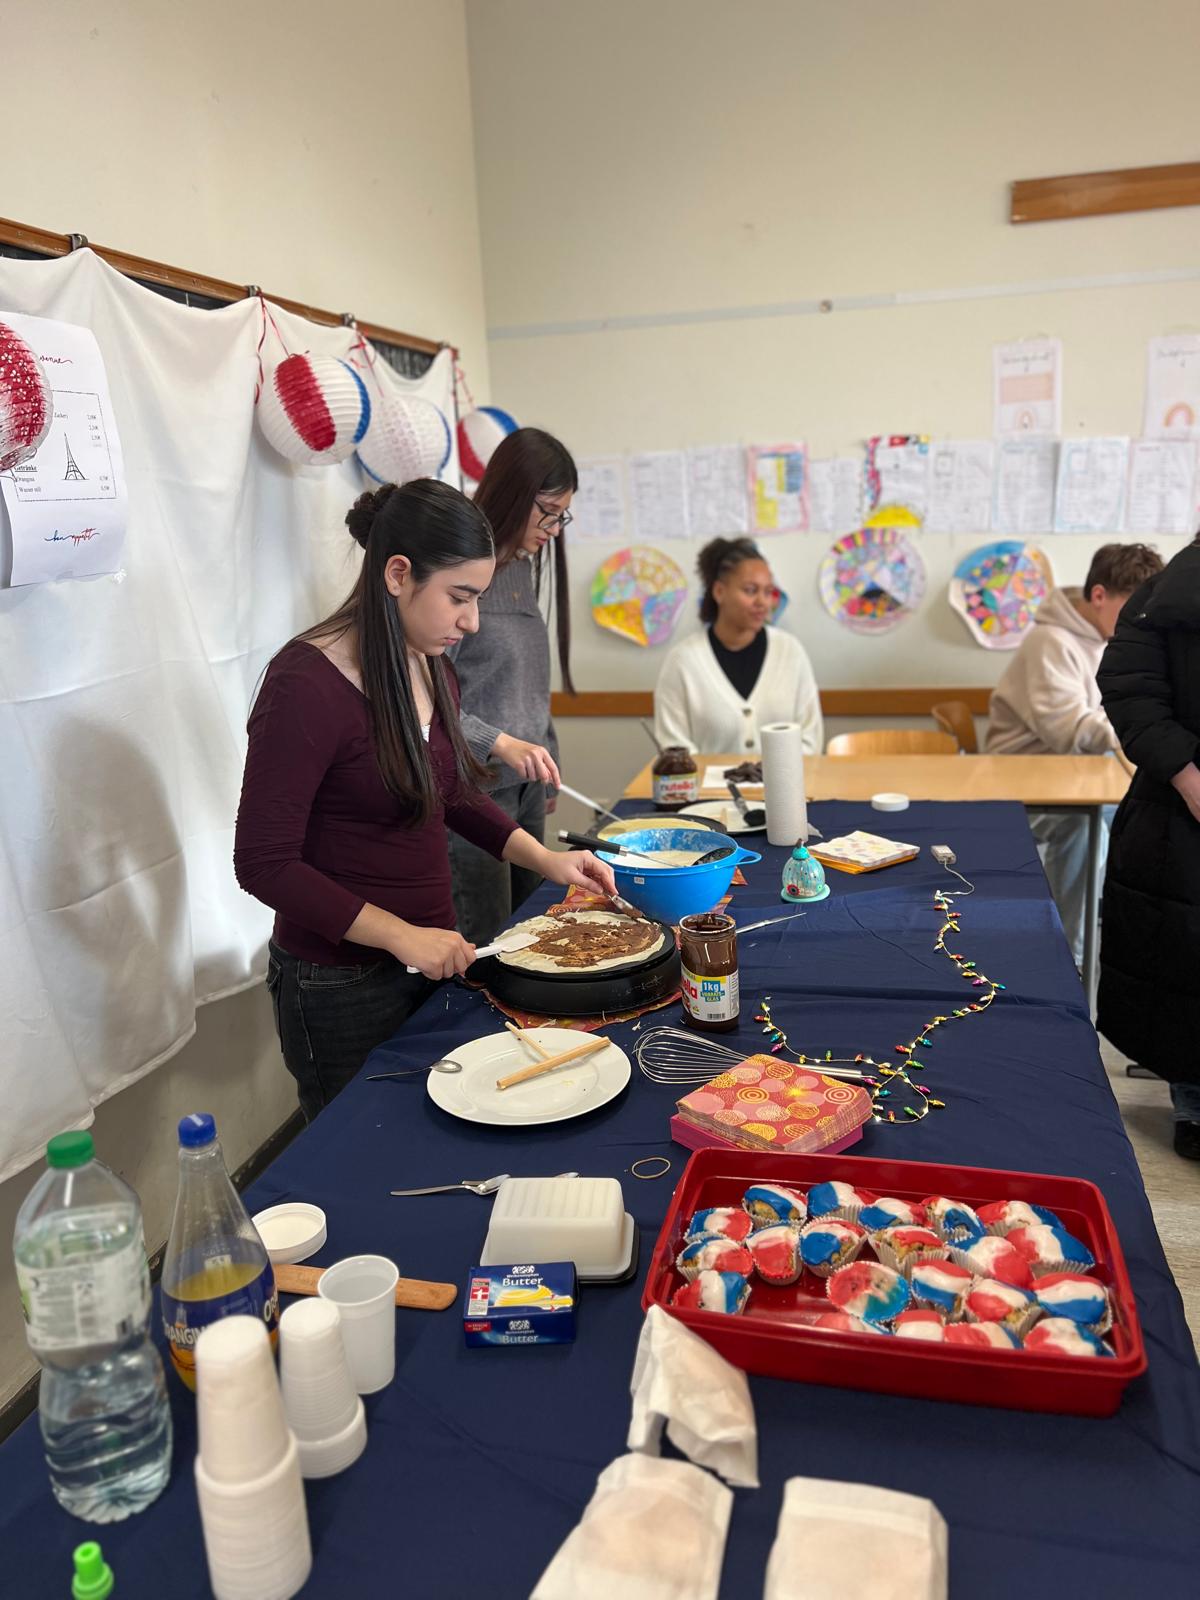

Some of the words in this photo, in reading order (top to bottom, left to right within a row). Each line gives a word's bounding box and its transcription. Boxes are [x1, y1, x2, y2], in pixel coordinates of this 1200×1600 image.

[660, 781, 694, 791] nutella
[502, 1277, 544, 1287] Butter
[502, 1335, 539, 1344] Butter
